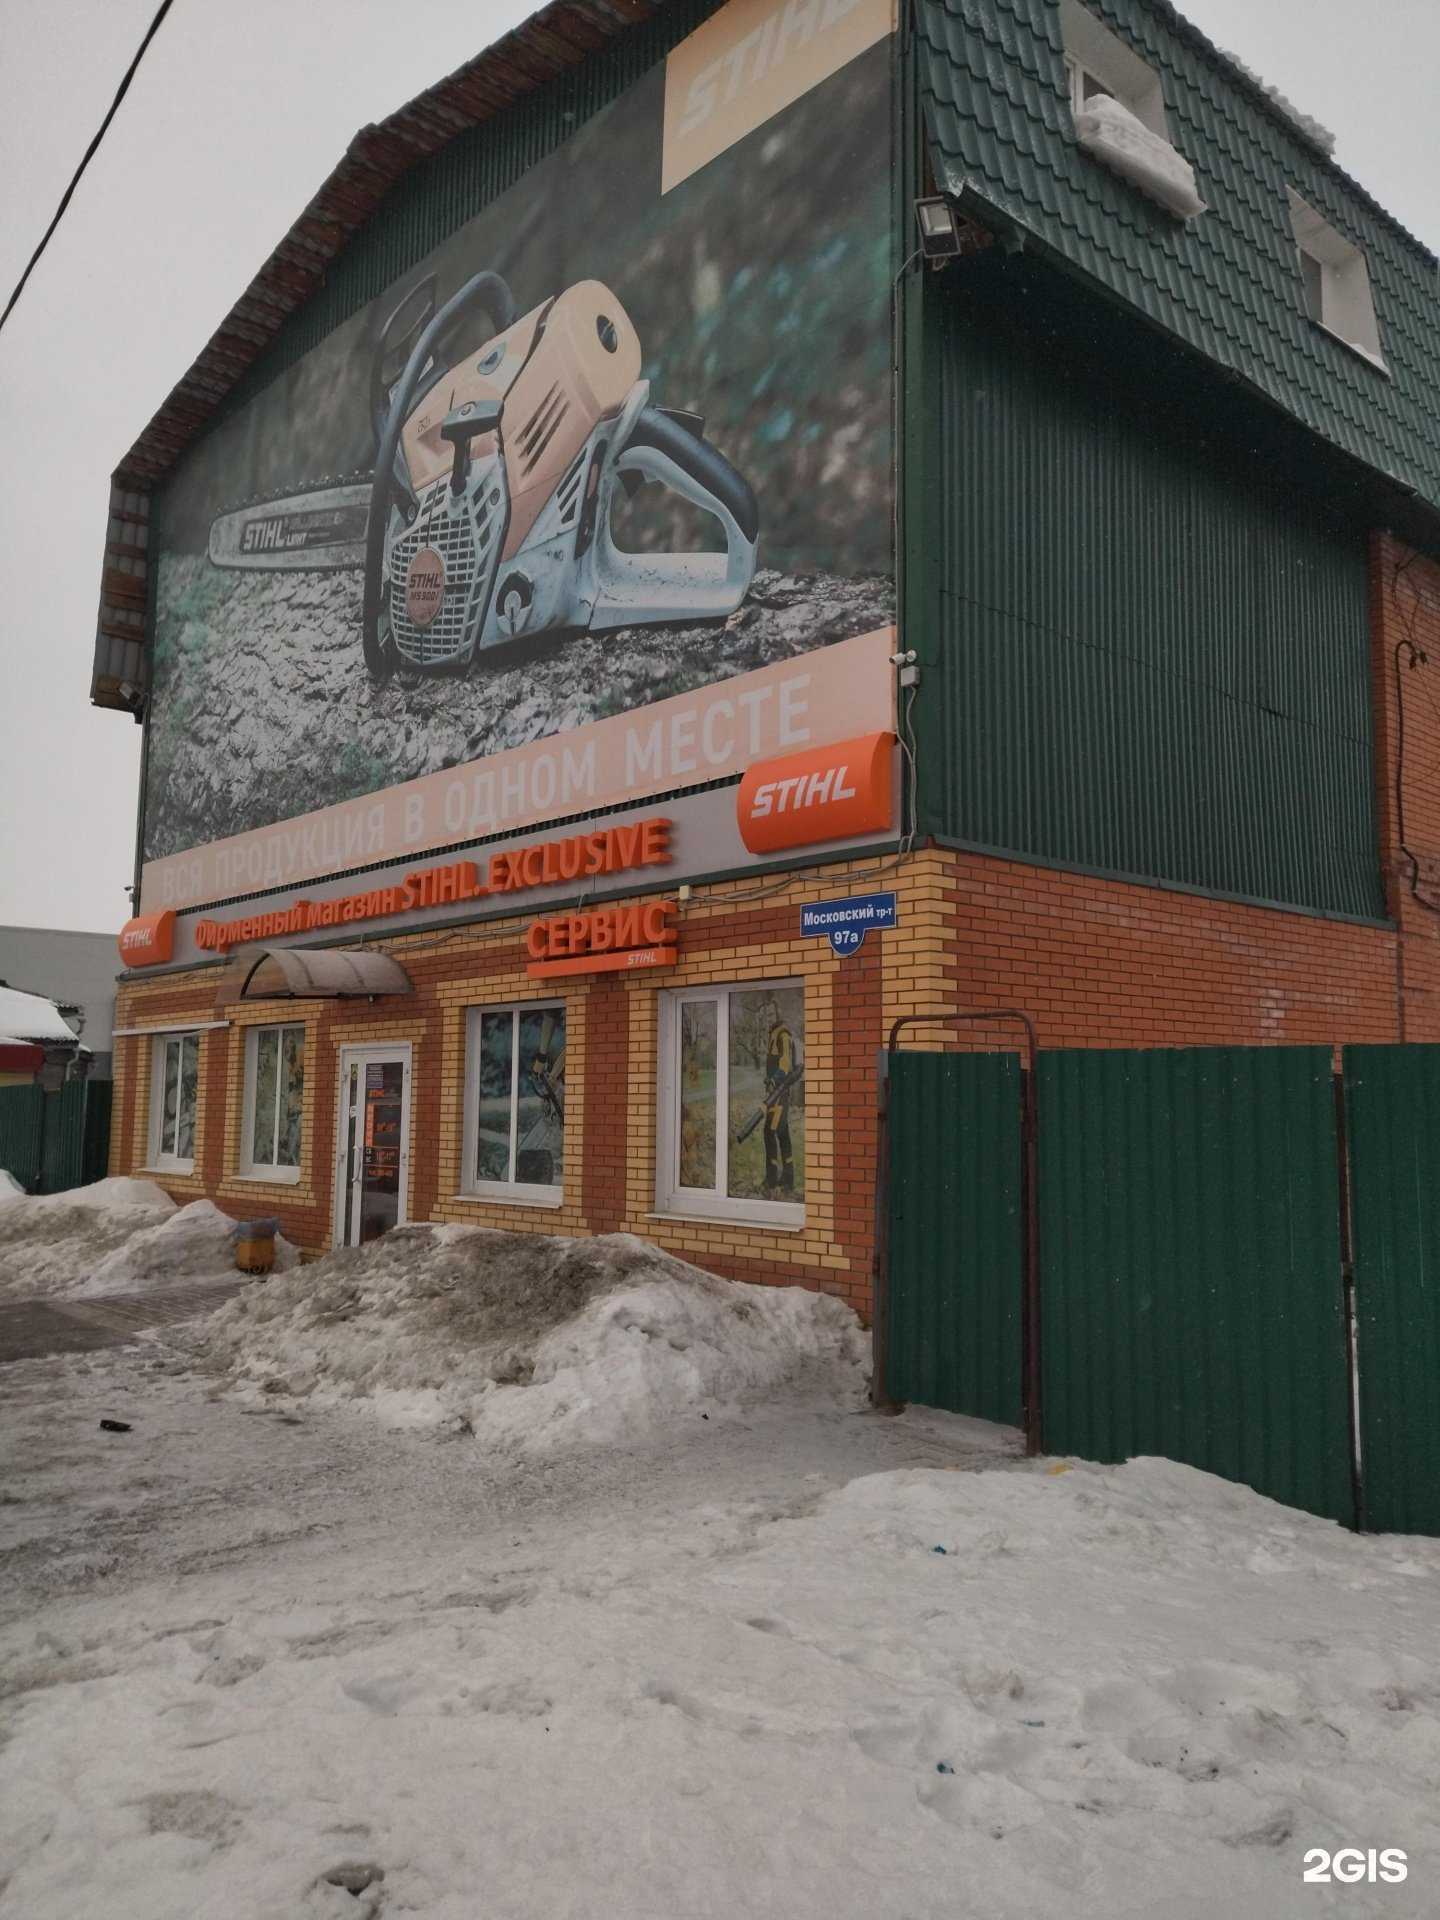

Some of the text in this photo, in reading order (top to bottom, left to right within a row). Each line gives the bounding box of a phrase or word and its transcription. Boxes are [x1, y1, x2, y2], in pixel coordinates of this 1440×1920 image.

[244, 520, 285, 550] STIHL
[409, 572, 441, 589] STIHL
[163, 674, 814, 903] ВСЯ ПРОДУКЦИЯ В ОДНОМ МЕСТЕ
[751, 766, 856, 819] STIHL
[196, 900, 310, 953] Фирменный
[306, 885, 402, 929] магазин
[487, 818, 672, 894] EXCLUSIVE
[804, 904, 892, 926] Московский тр-т
[122, 928, 153, 950] STIHL
[527, 902, 678, 959] СЕРВИС
[834, 930, 859, 945] 97а
[627, 951, 657, 966] STIHL
